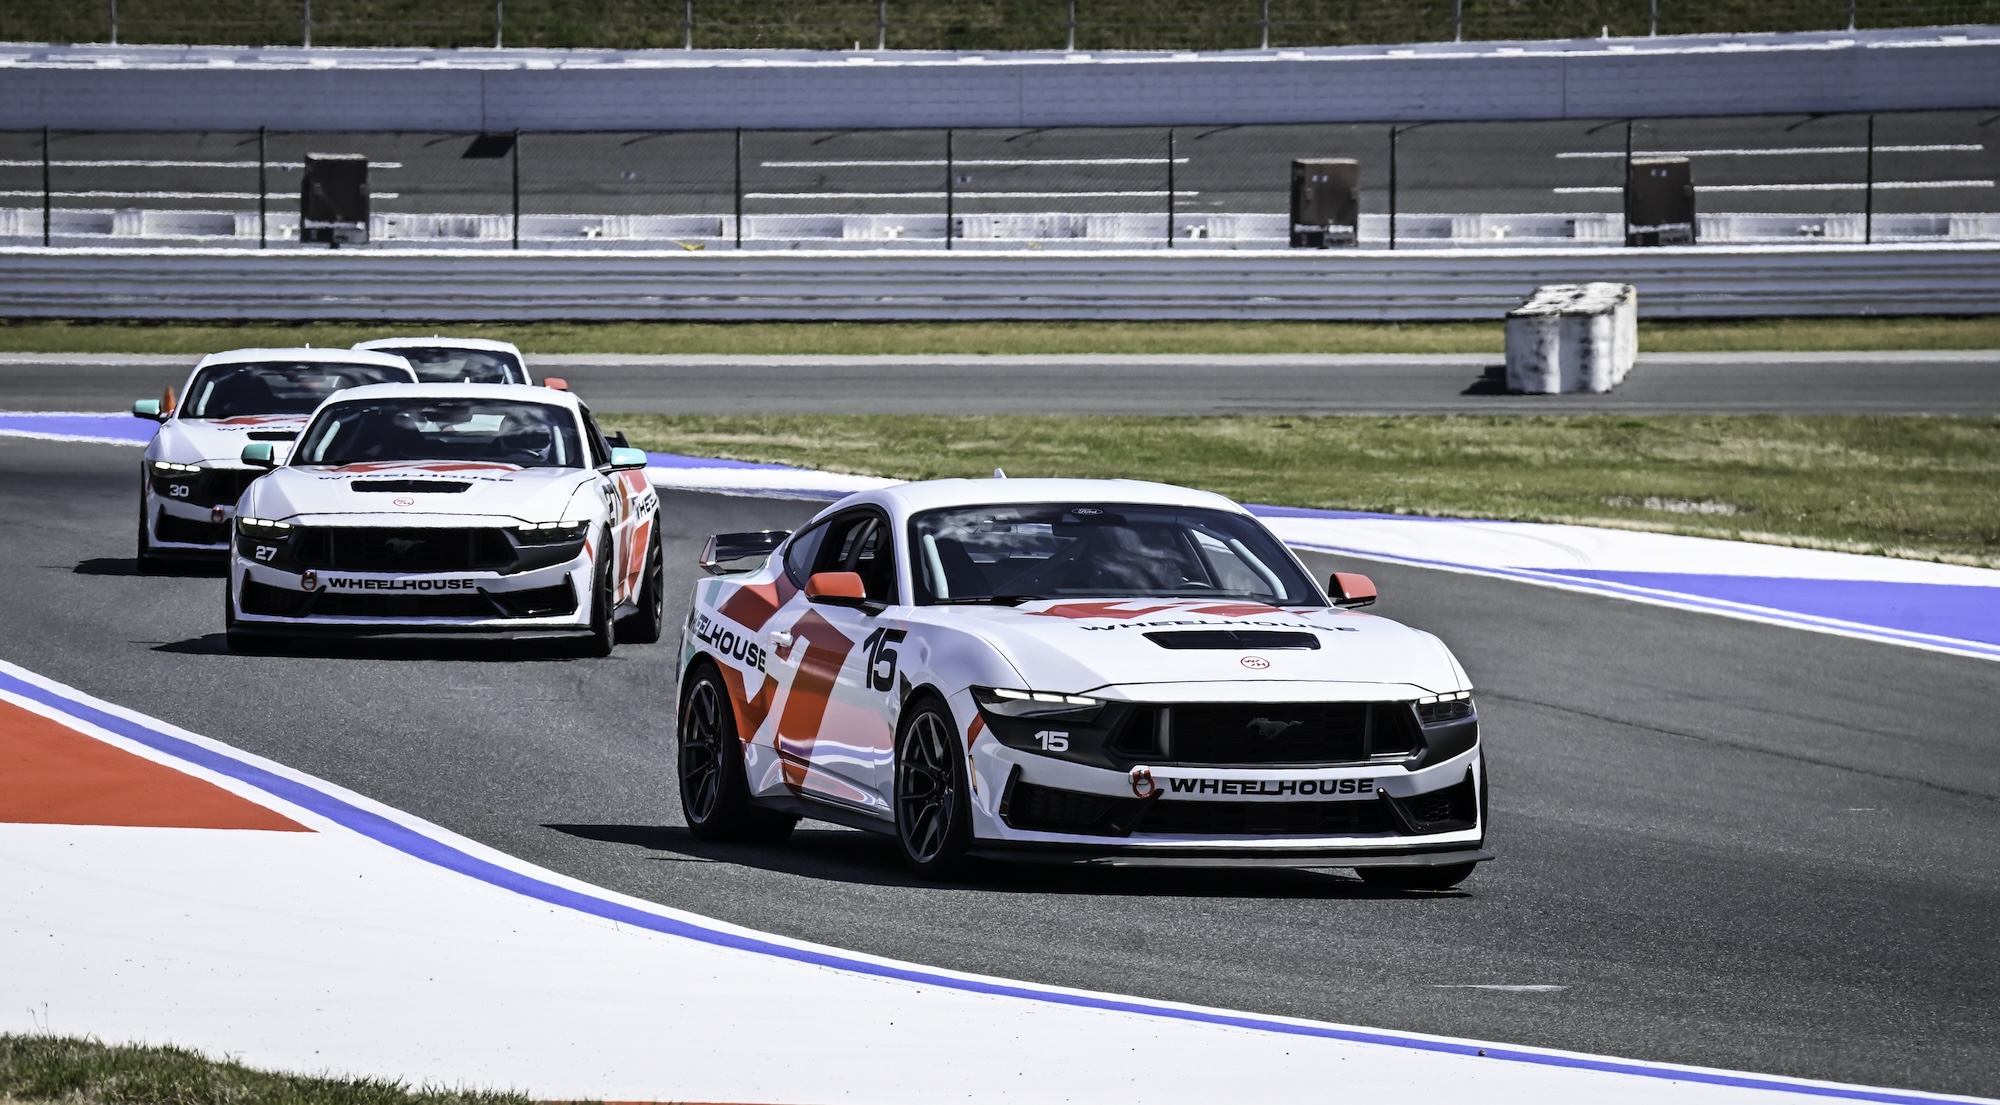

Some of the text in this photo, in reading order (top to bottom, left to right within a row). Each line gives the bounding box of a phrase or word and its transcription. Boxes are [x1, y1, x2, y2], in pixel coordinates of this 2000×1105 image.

[169, 484, 189, 497] 30
[255, 546, 277, 561] 27
[328, 578, 474, 591] WHEELHOUSE
[1079, 619, 1360, 632] WHEELHOUSE
[862, 627, 908, 692] 15
[1034, 731, 1069, 752] 15
[1169, 777, 1374, 796] WHEELHOUSE
